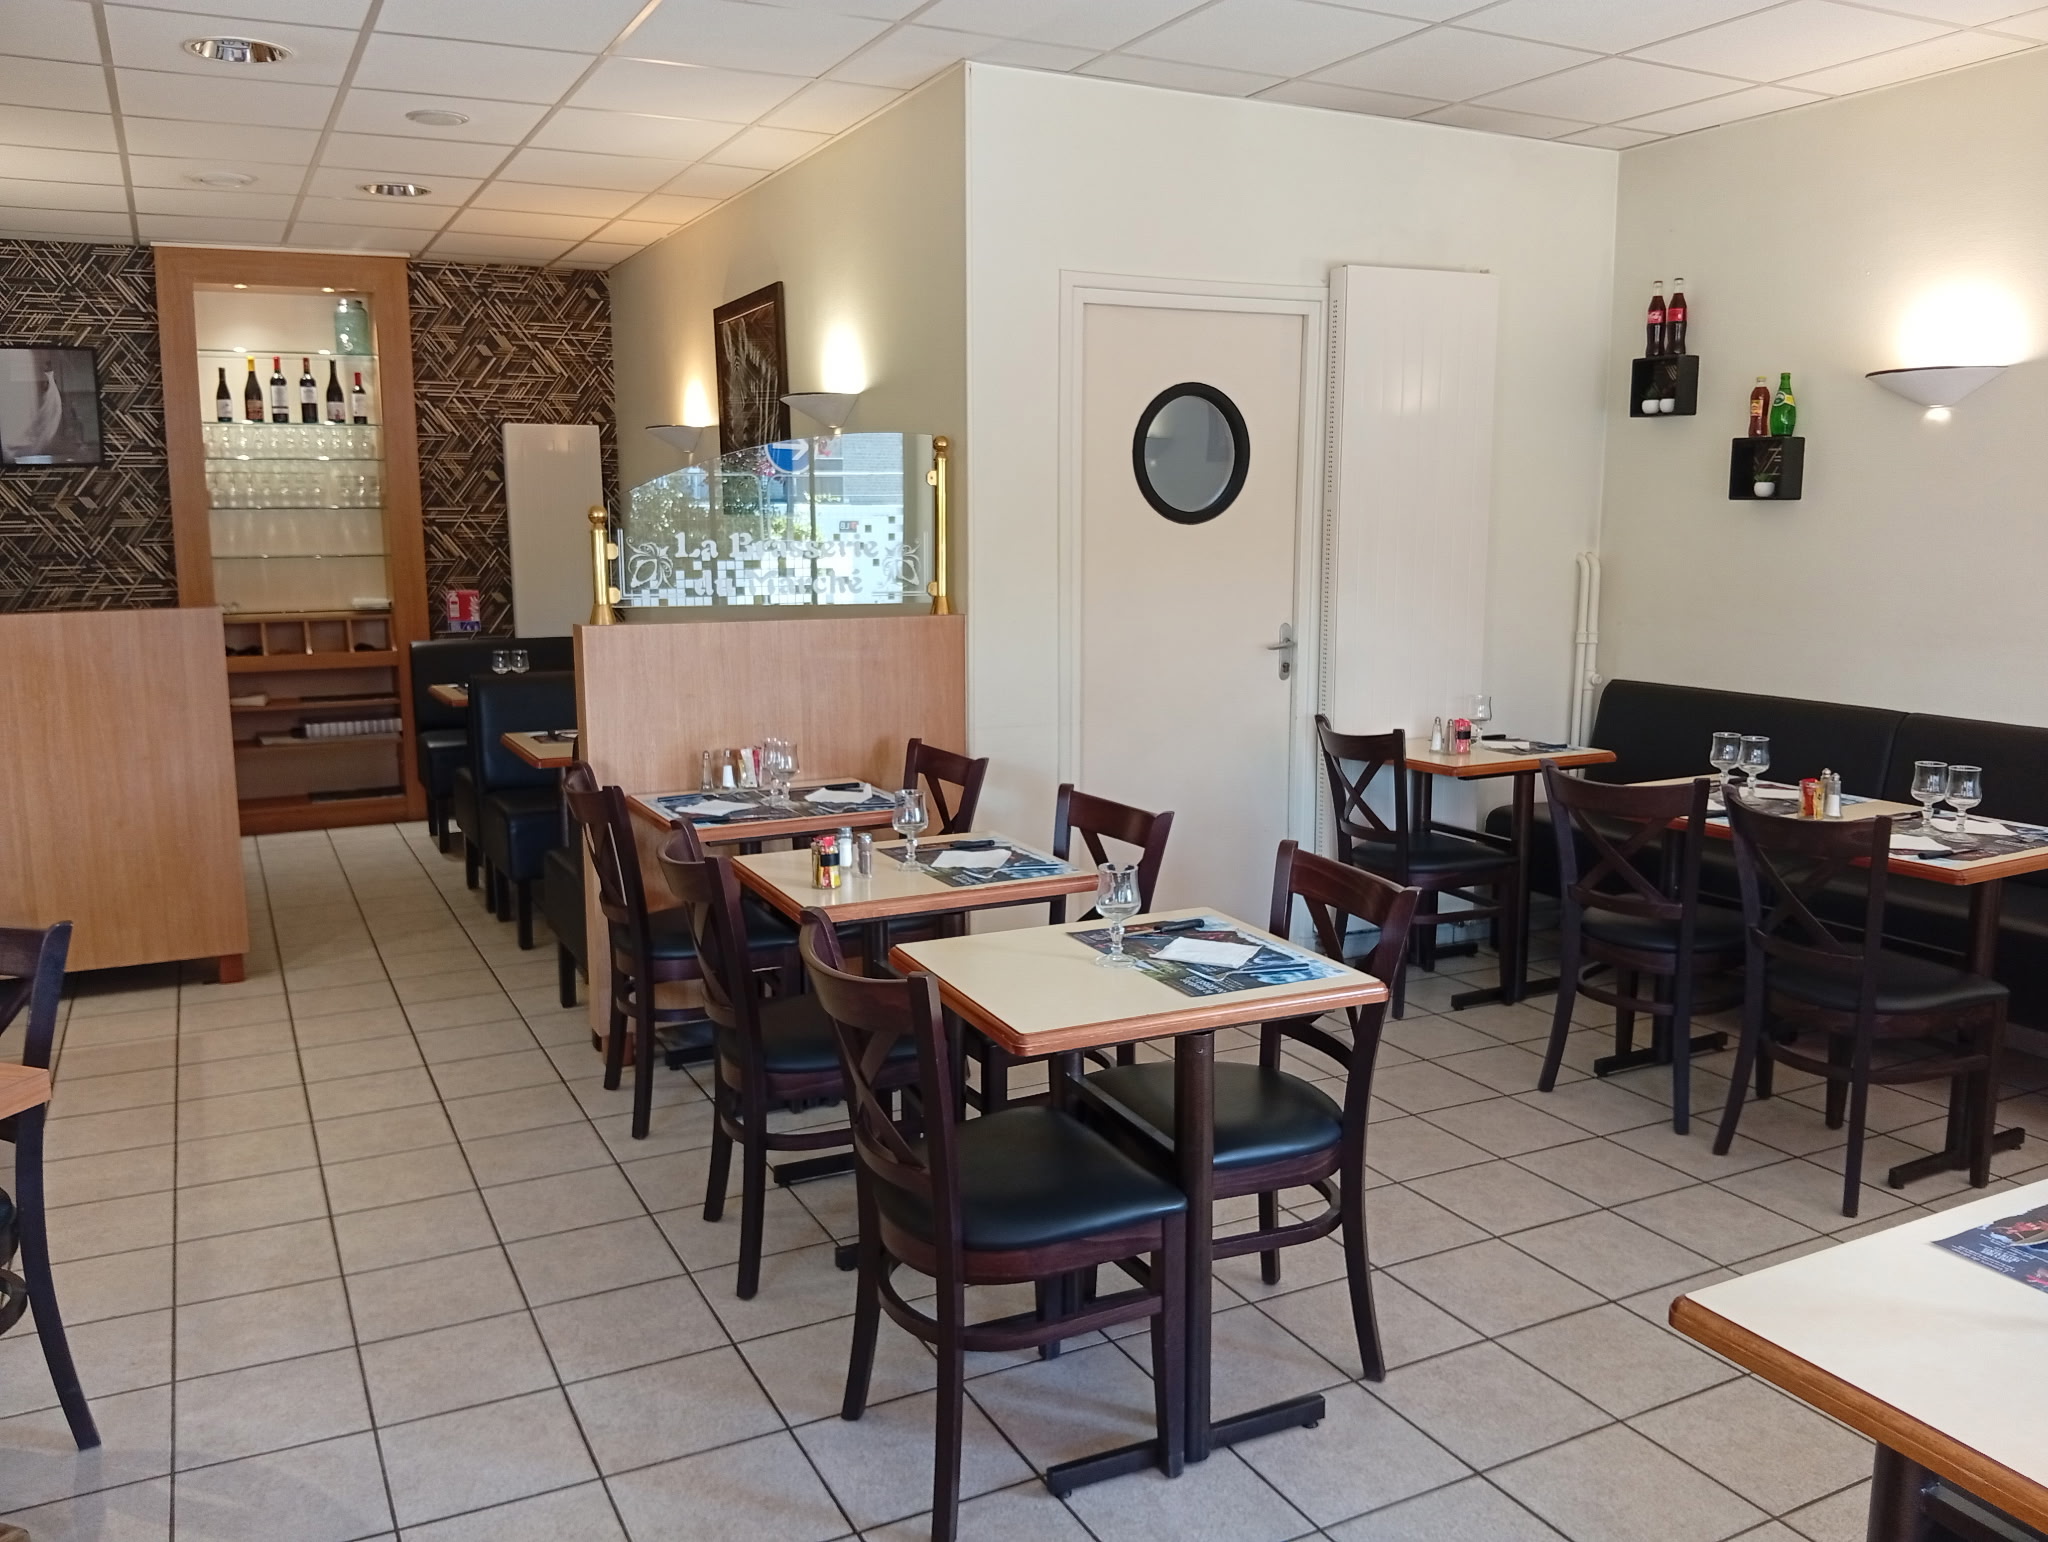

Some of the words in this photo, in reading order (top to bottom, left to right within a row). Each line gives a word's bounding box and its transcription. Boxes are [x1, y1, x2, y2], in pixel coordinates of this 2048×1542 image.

[674, 532, 718, 560] La
[729, 532, 879, 559] Brasserie
[694, 569, 737, 597] du
[744, 568, 863, 595] Marché
